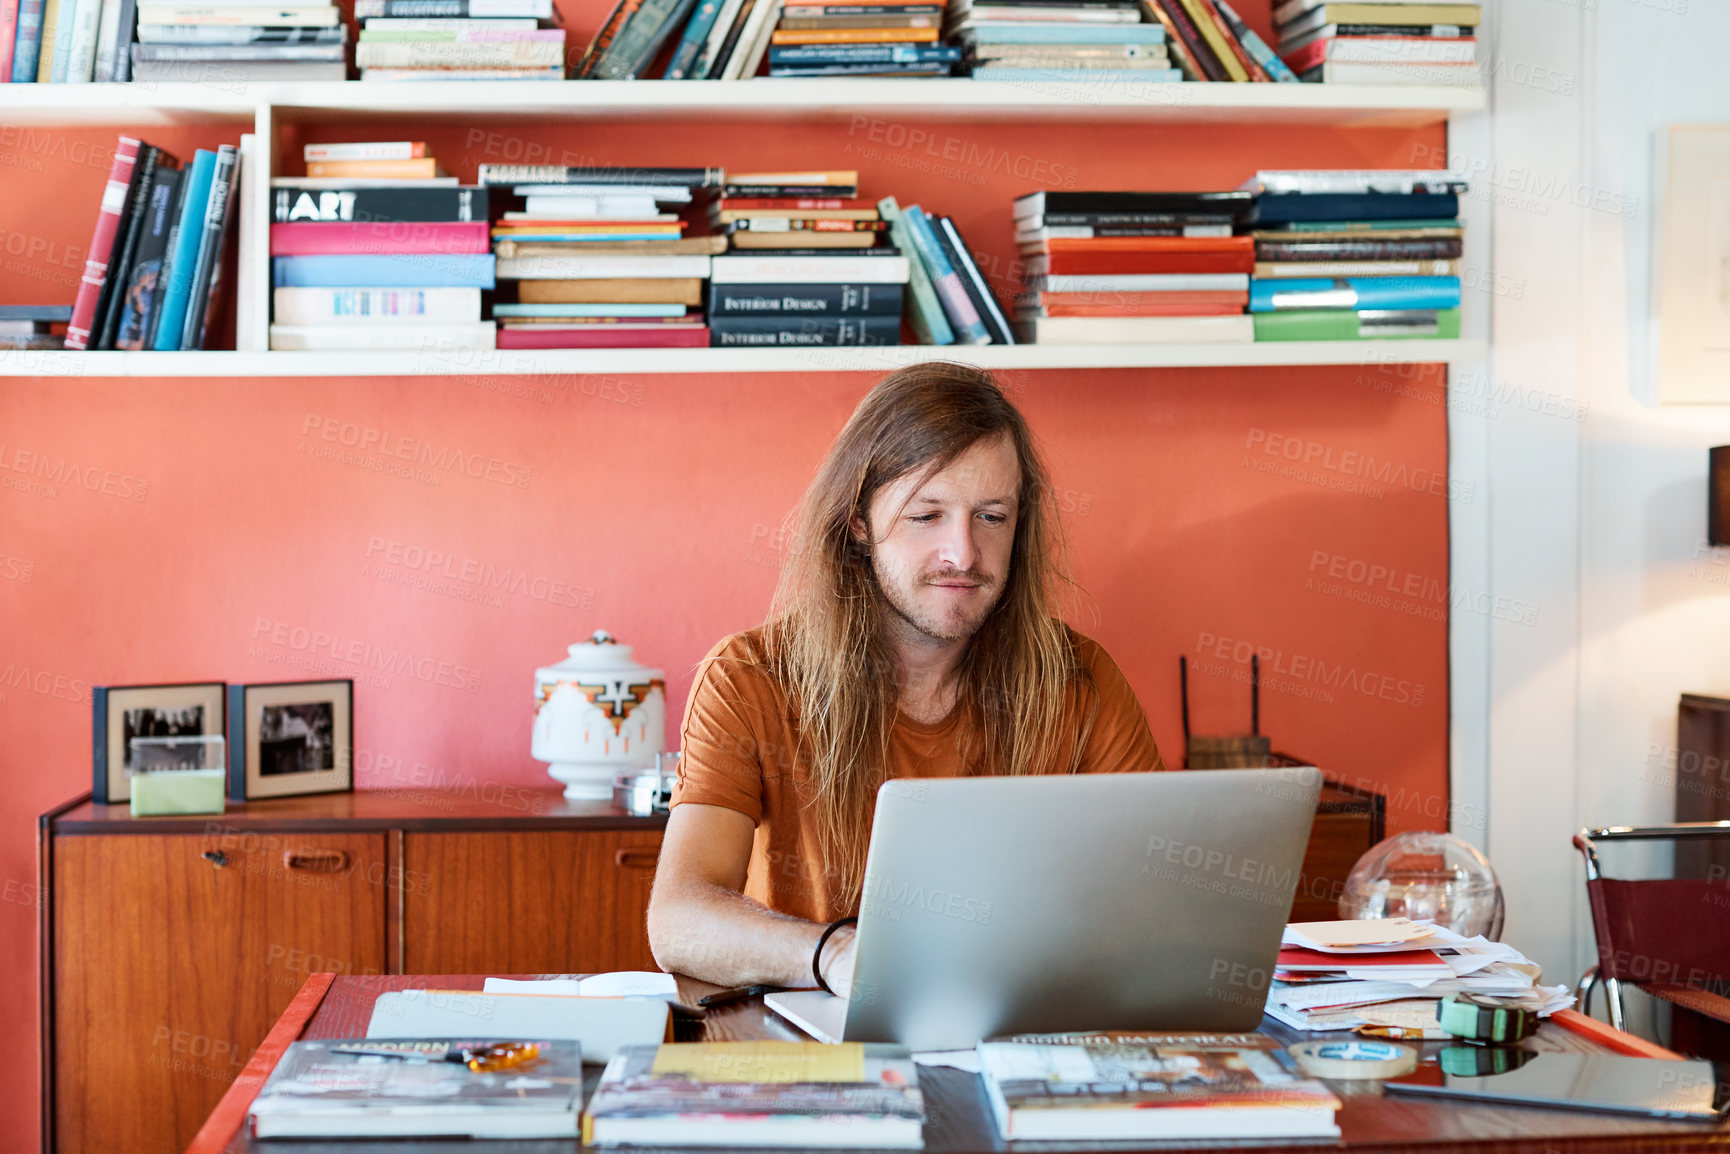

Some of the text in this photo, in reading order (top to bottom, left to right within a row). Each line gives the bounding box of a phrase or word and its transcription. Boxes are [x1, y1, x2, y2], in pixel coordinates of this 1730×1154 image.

[289, 192, 357, 221] ART
[724, 297, 781, 310] INTERIOR
[782, 297, 828, 310] DESIGN
[720, 332, 777, 344] INTERIOR
